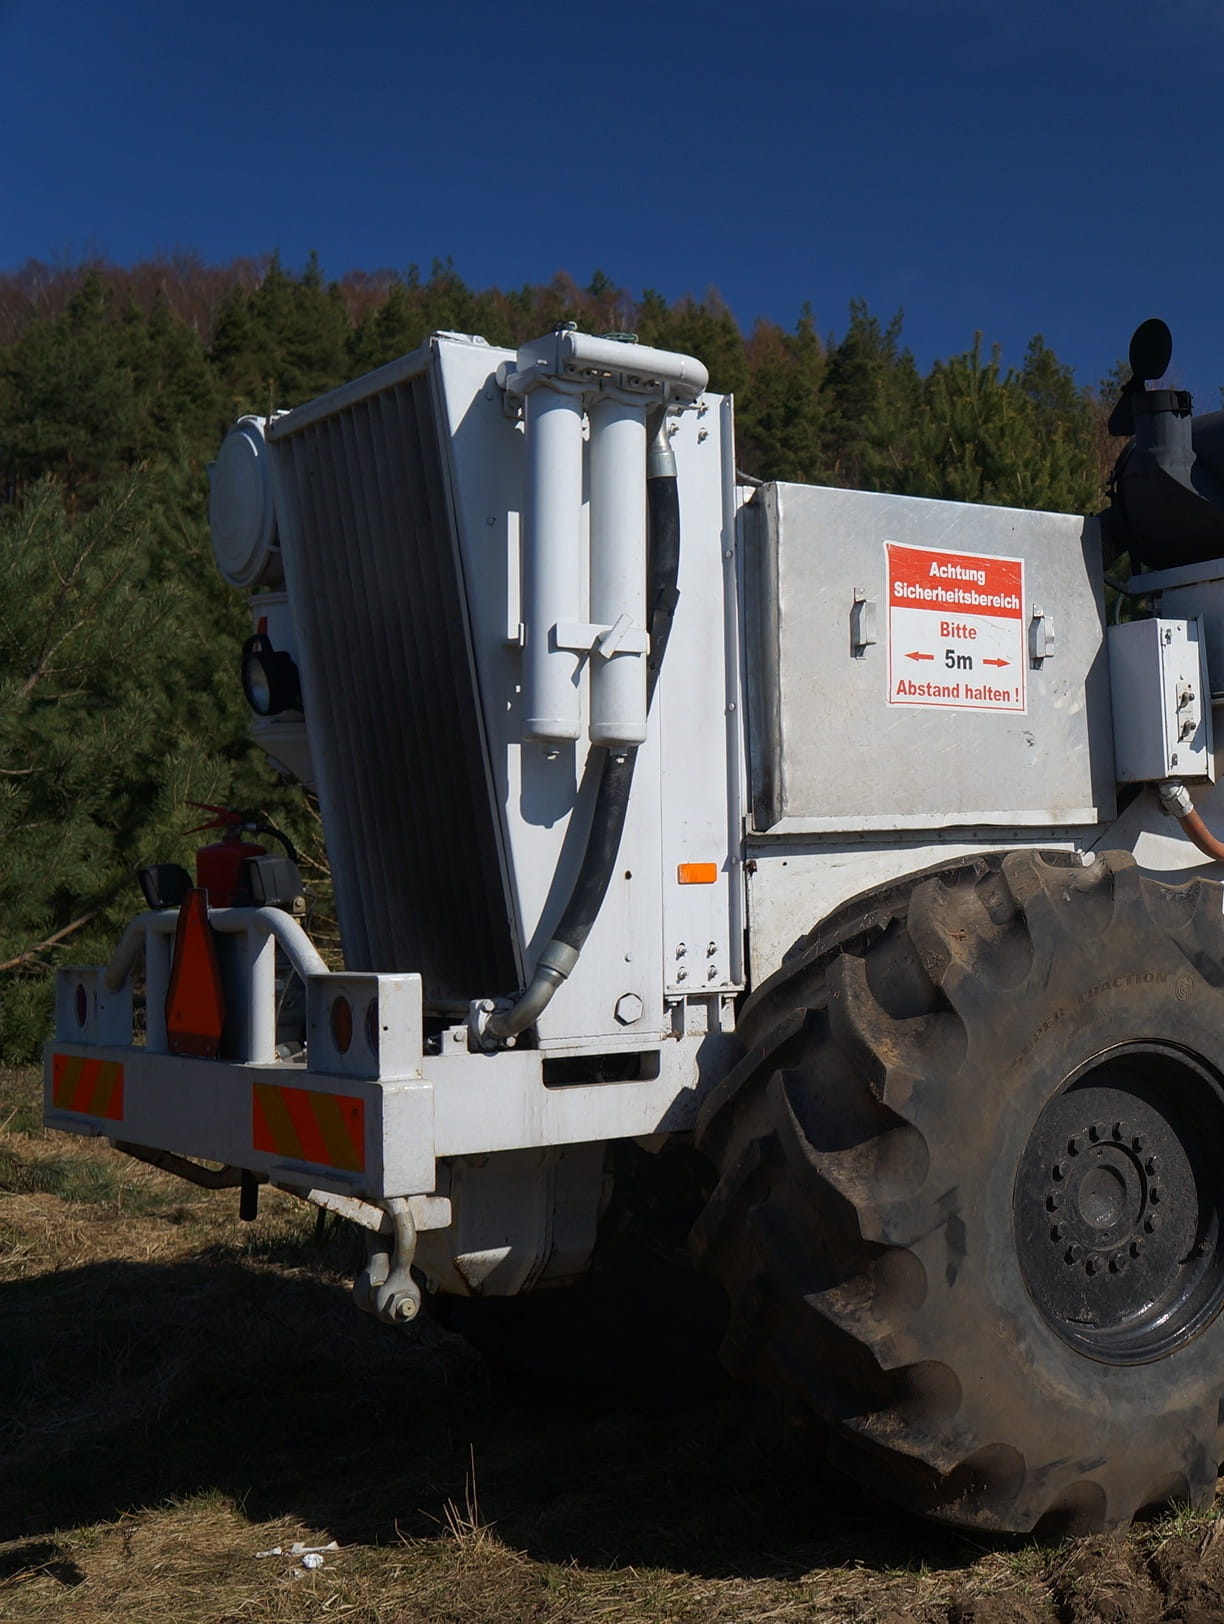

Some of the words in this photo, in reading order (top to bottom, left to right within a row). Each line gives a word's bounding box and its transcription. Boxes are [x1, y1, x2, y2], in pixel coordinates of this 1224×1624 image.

[928, 561, 986, 586] Achtung
[893, 581, 1020, 610] Sicherheitsbereich
[939, 621, 977, 640] Bitte
[944, 648, 973, 671] 5m
[896, 679, 960, 699] Abstand
[965, 683, 1011, 702] halten
